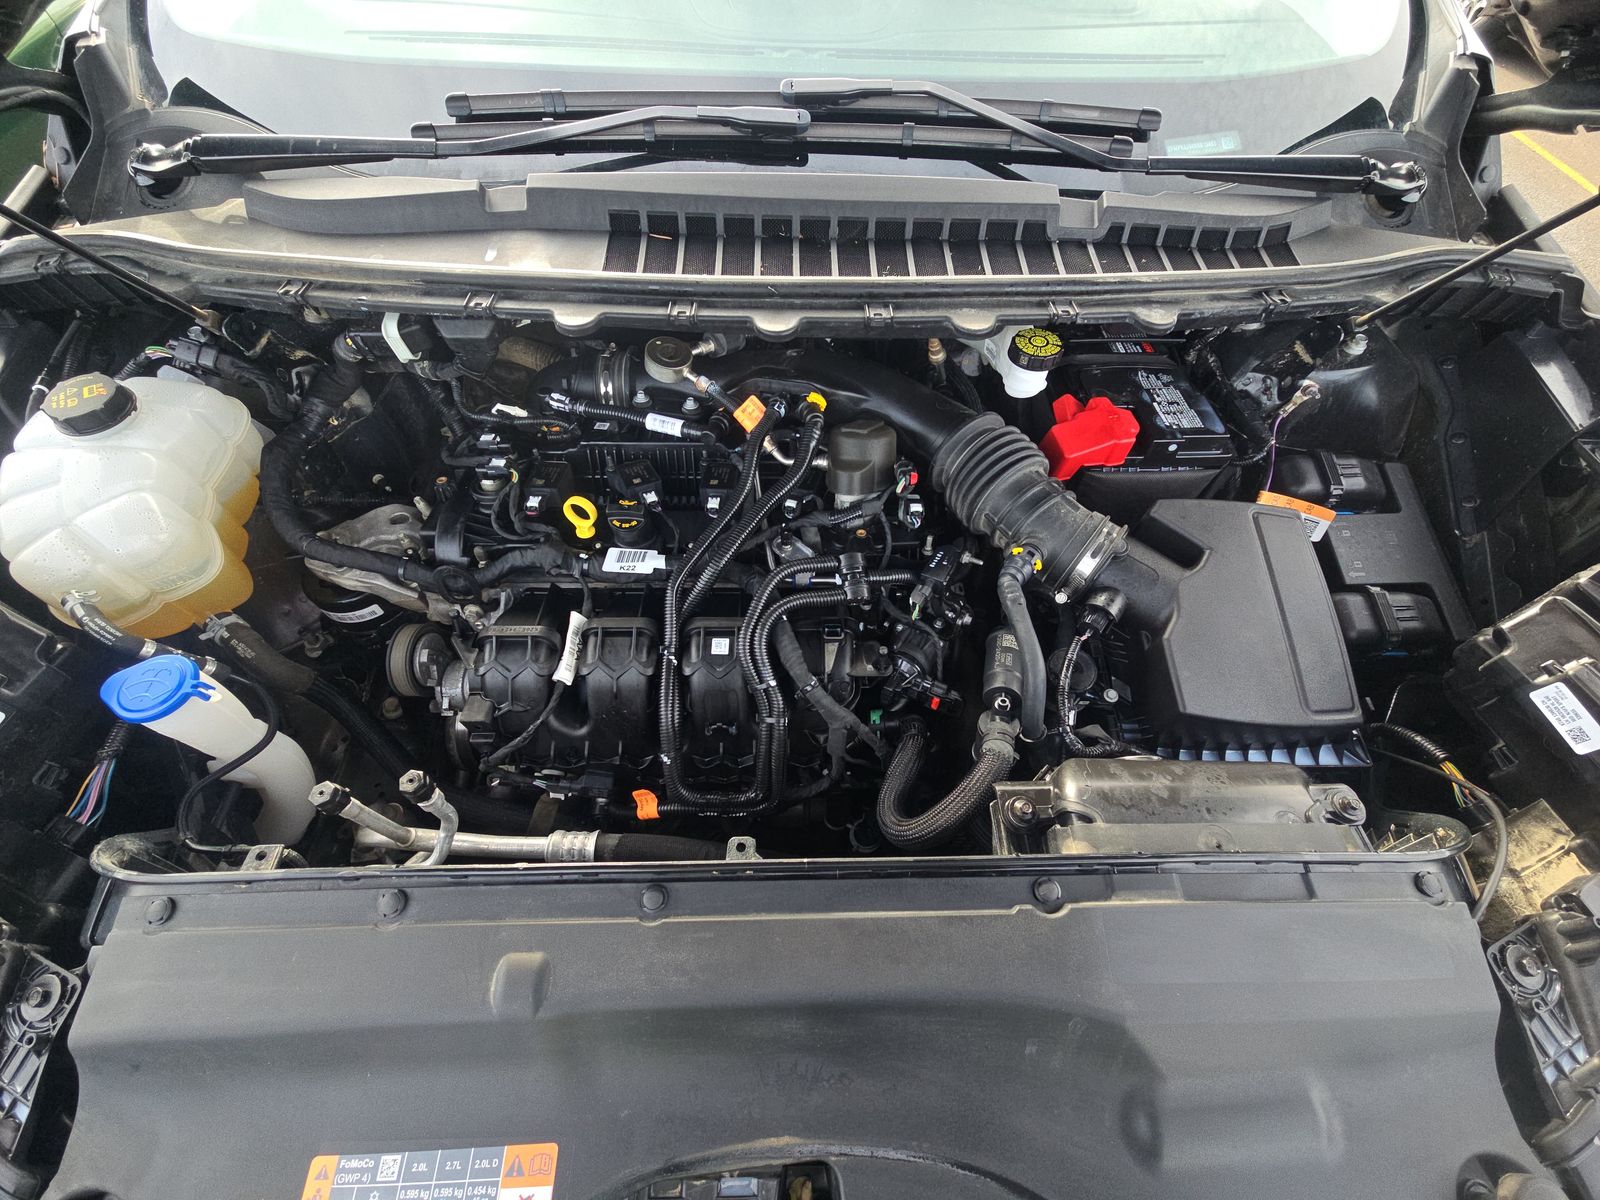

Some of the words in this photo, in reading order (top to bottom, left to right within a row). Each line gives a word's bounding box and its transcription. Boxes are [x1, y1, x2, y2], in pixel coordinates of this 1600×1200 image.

[339, 1158, 375, 1168] FoMoCo
[411, 1163, 428, 1172] 2.0L
[445, 1161, 461, 1170] 2.7L
[474, 1159, 490, 1168] 2.0L
[492, 1159, 499, 1167] D
[334, 1173, 361, 1185] (GWP
[361, 1173, 371, 1184] 4)
[399, 1189, 419, 1198] 0.595
[419, 1189, 430, 1200] kg
[433, 1187, 453, 1198] 0.595
[453, 1187, 464, 1198] kg
[467, 1186, 486, 1196] 0.454
[487, 1185, 497, 1196] kg
